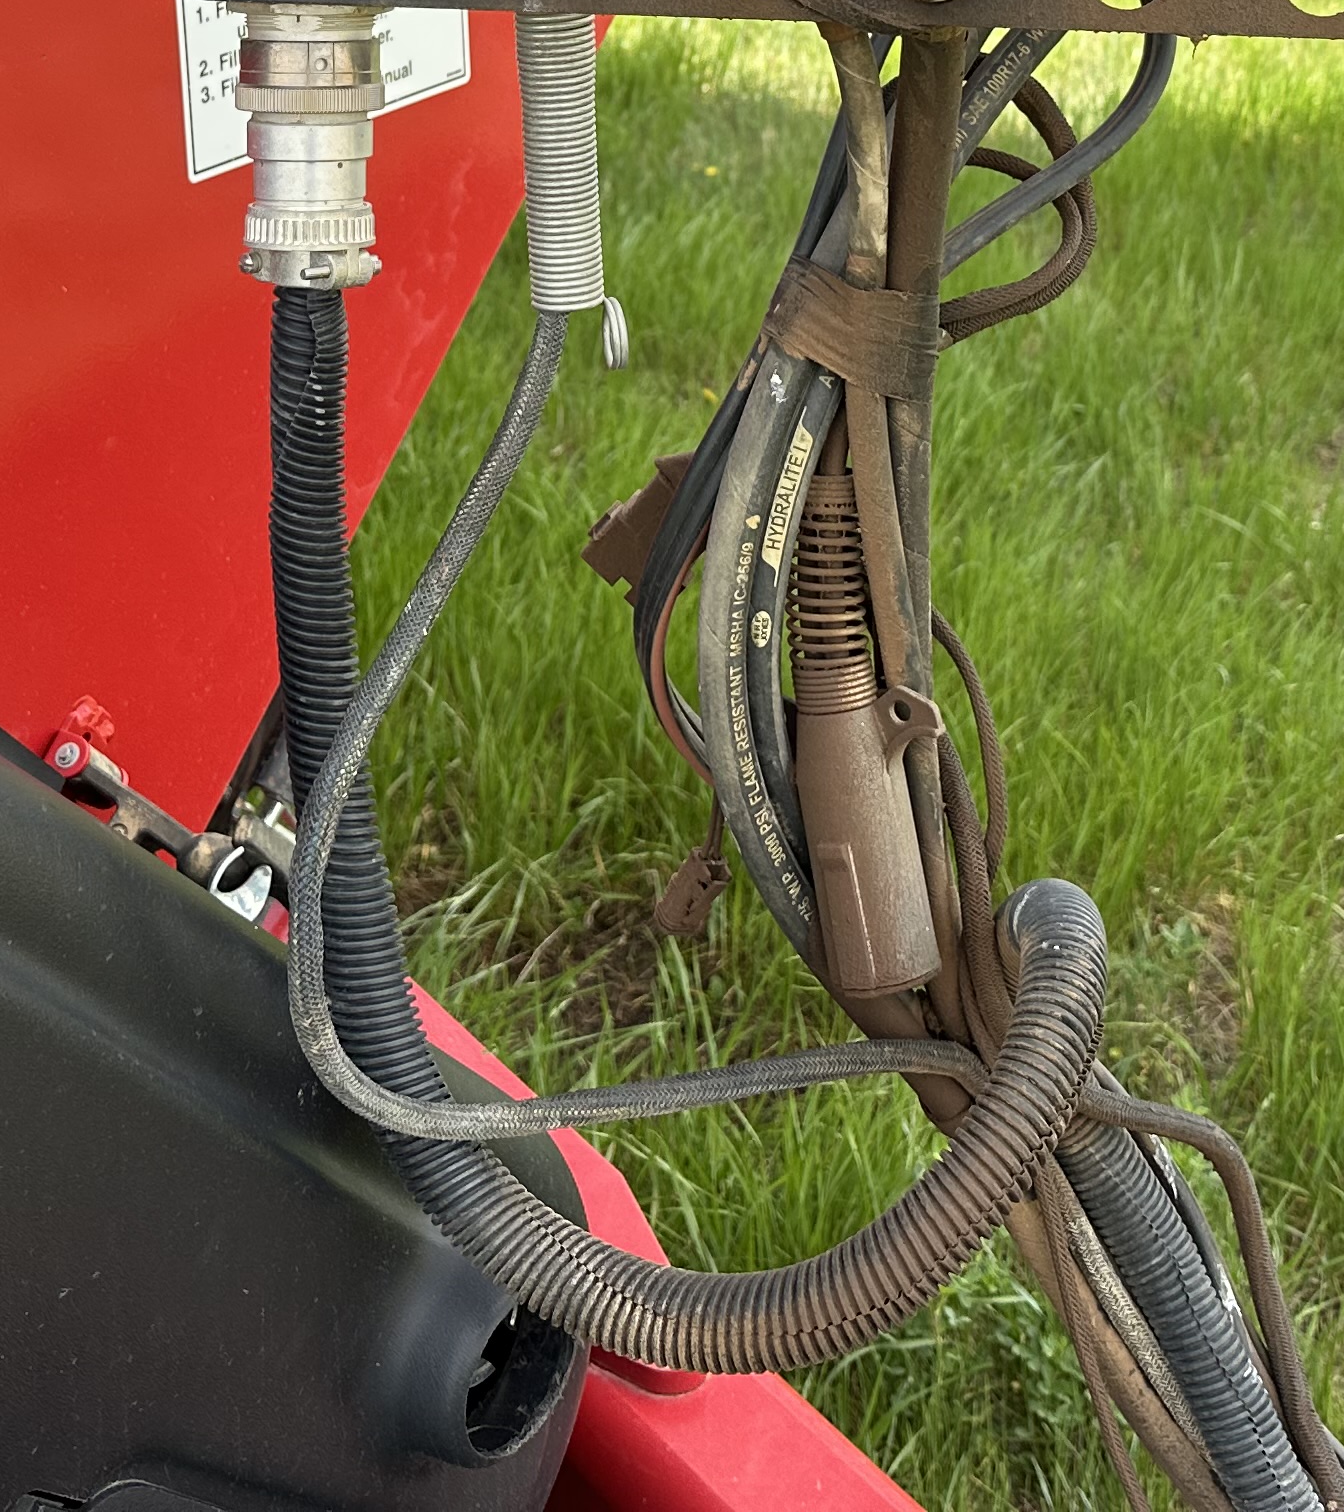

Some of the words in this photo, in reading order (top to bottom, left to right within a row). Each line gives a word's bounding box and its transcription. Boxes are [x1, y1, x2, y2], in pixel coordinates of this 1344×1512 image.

[196, 6, 210, 24] 1.
[198, 59, 214, 78] 2.
[200, 86, 216, 104] 3.
[381, 59, 413, 85] nual
[961, 95, 991, 126] SAE
[982, 41, 1031, 99] 100R17-6
[765, 453, 805, 551] HYDRALITE
[733, 542, 755, 605] IC-256/9
[729, 609, 744, 657] MSHA
[729, 666, 751, 753] RESISTANT
[737, 752, 763, 806] FLAME
[754, 806, 773, 836] PSI
[764, 832, 787, 867] 3000
